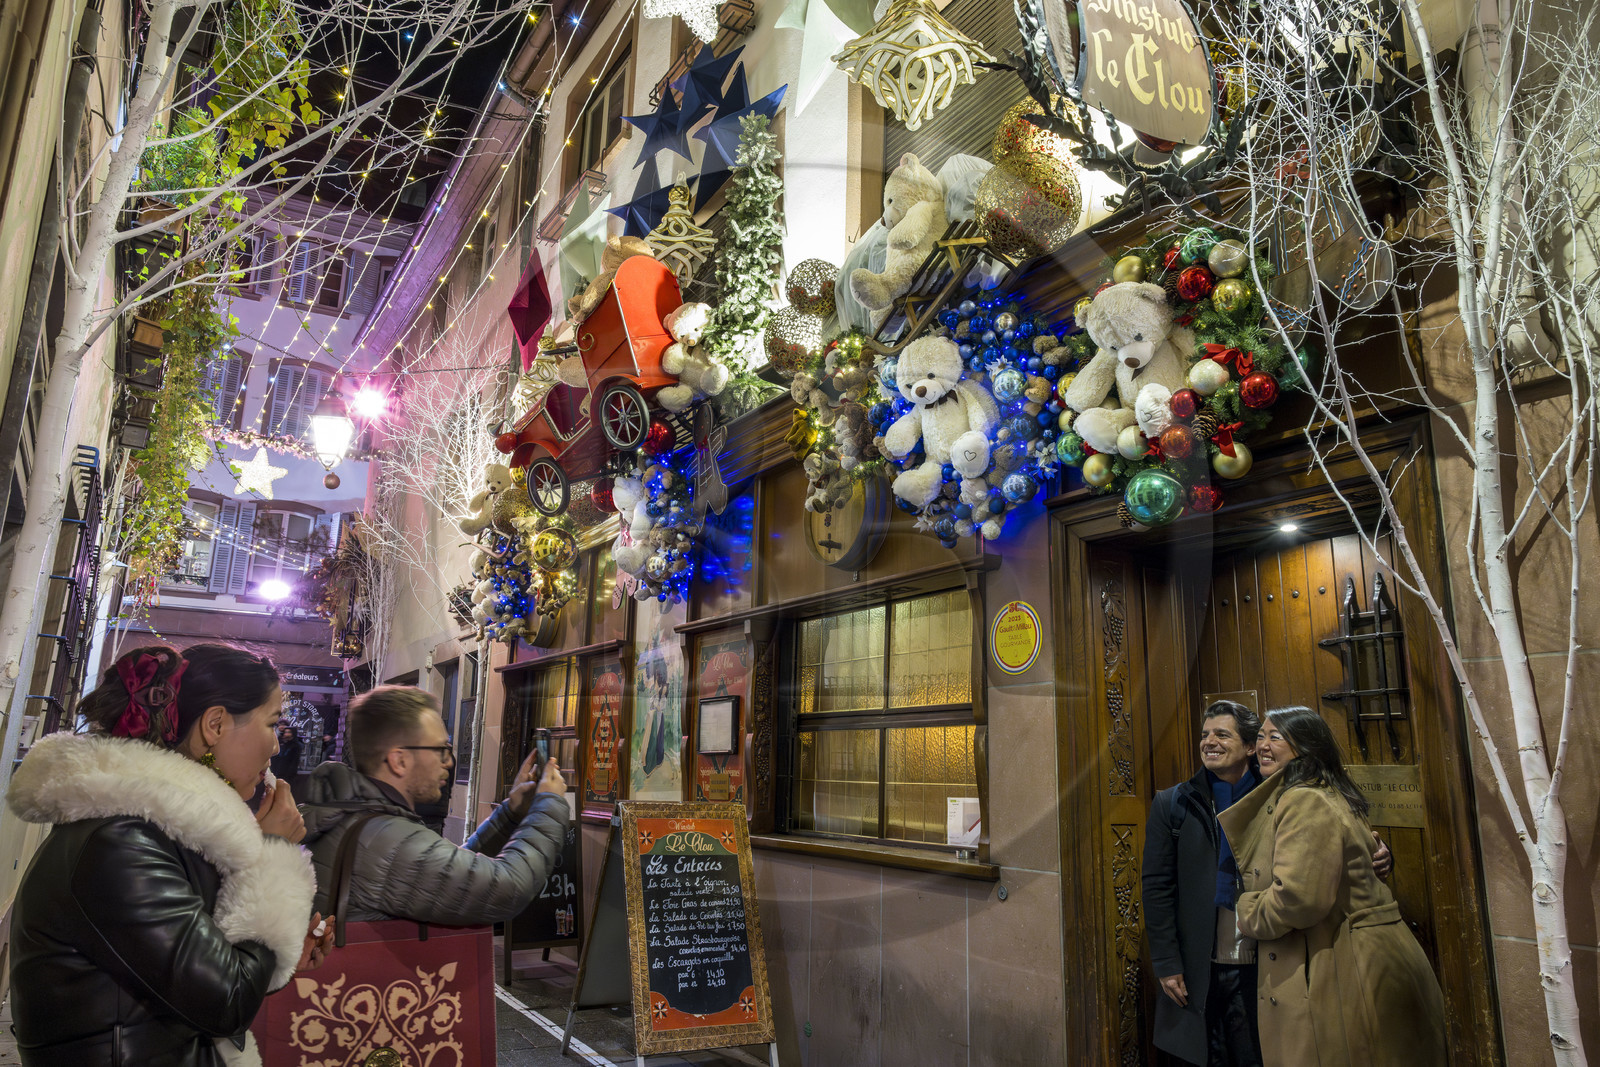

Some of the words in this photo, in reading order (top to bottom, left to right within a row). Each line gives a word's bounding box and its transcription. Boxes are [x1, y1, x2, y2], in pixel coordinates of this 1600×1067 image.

[1125, 33, 1206, 115] Clou
[302, 701, 320, 717] STORE
[665, 833, 686, 852] Le
[685, 831, 715, 855] Clou
[645, 855, 668, 876] Les
[673, 856, 723, 874] Entrées
[540, 873, 576, 899] 23h
[647, 878, 660, 890] La
[684, 877, 691, 887] à
[669, 887, 693, 897] salade
[649, 911, 660, 922] La
[662, 910, 687, 922] Salade
[649, 923, 661, 934] La
[663, 923, 687, 934] Salade
[650, 936, 662, 948] La
[664, 936, 690, 948] Salade
[667, 955, 702, 972] Escargots
[691, 971, 696, 979] 6
